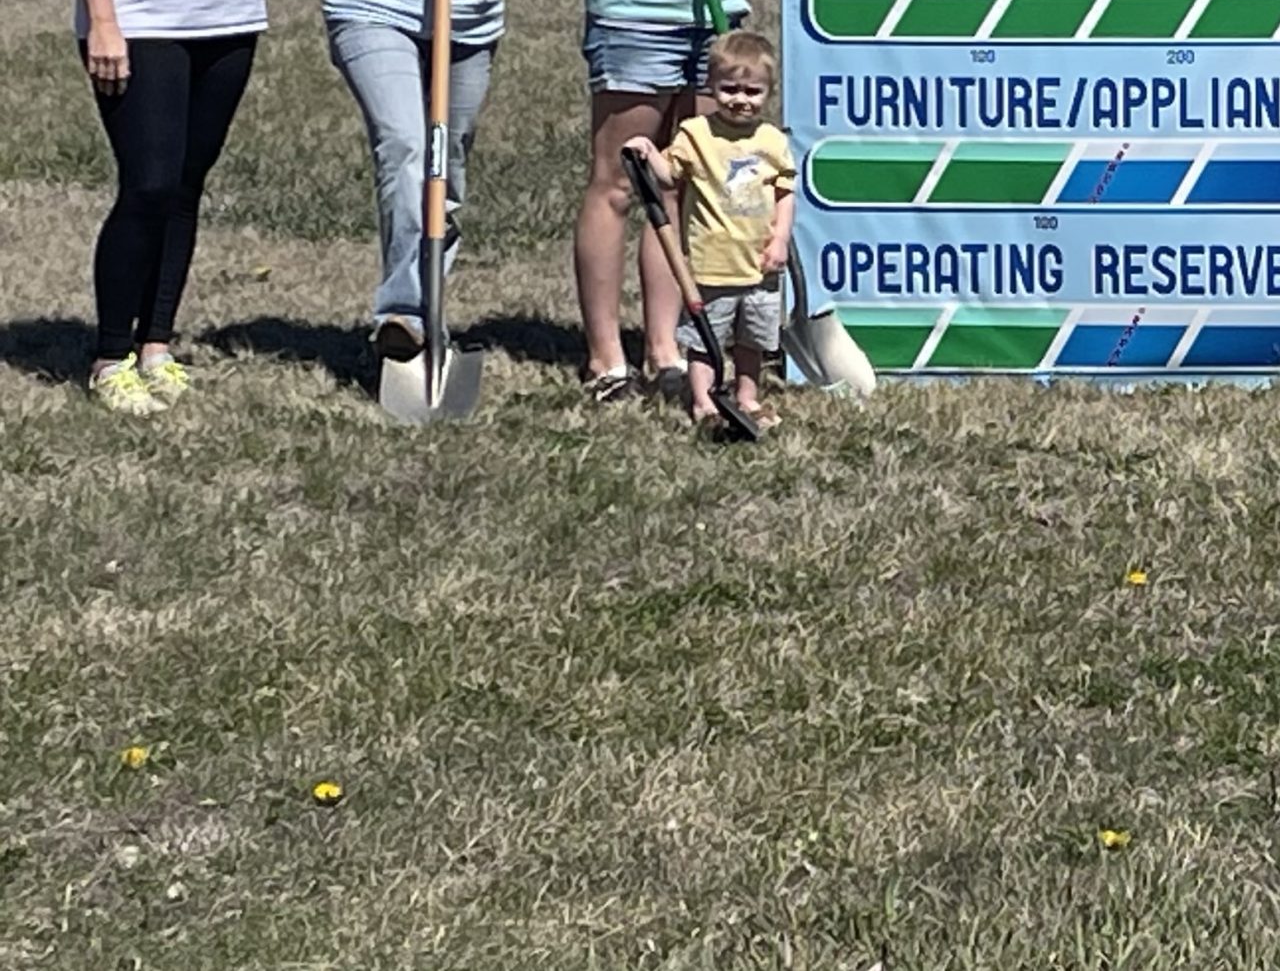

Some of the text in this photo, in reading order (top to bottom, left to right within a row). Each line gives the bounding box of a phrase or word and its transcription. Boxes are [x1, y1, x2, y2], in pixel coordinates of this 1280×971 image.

[970, 49, 996, 64] 100
[1167, 49, 1195, 65] 200
[1034, 216, 1058, 231] 100
[820, 243, 1064, 295] OPERATING
